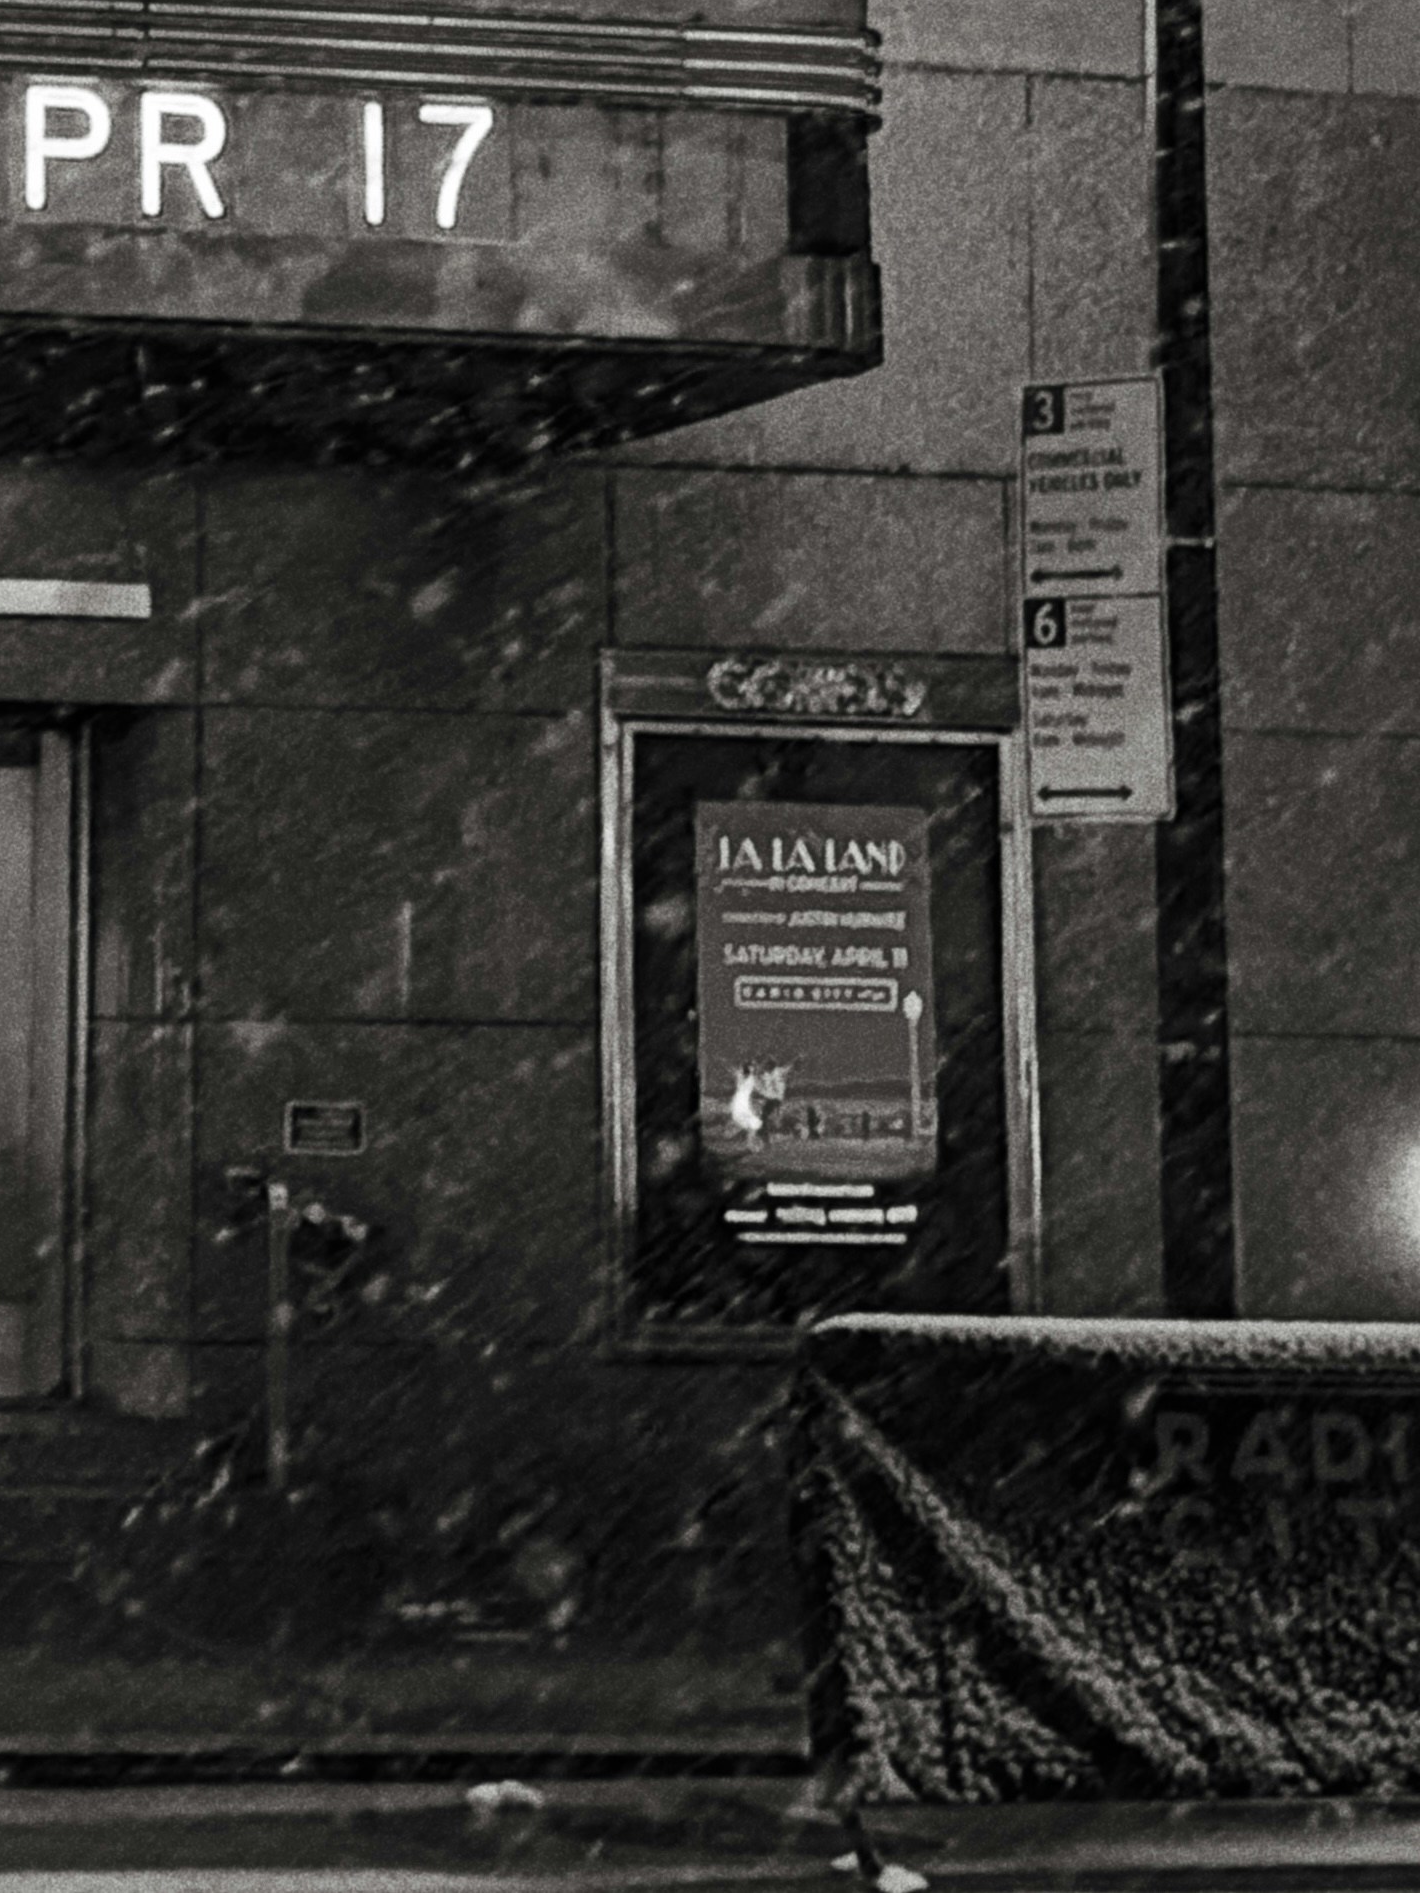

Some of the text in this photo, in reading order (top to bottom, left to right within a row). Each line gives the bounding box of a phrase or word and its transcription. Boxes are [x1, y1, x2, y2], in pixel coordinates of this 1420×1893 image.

[363, 101, 495, 229] 17
[1033, 390, 1054, 431] 3
[1033, 603, 1057, 645] 6
